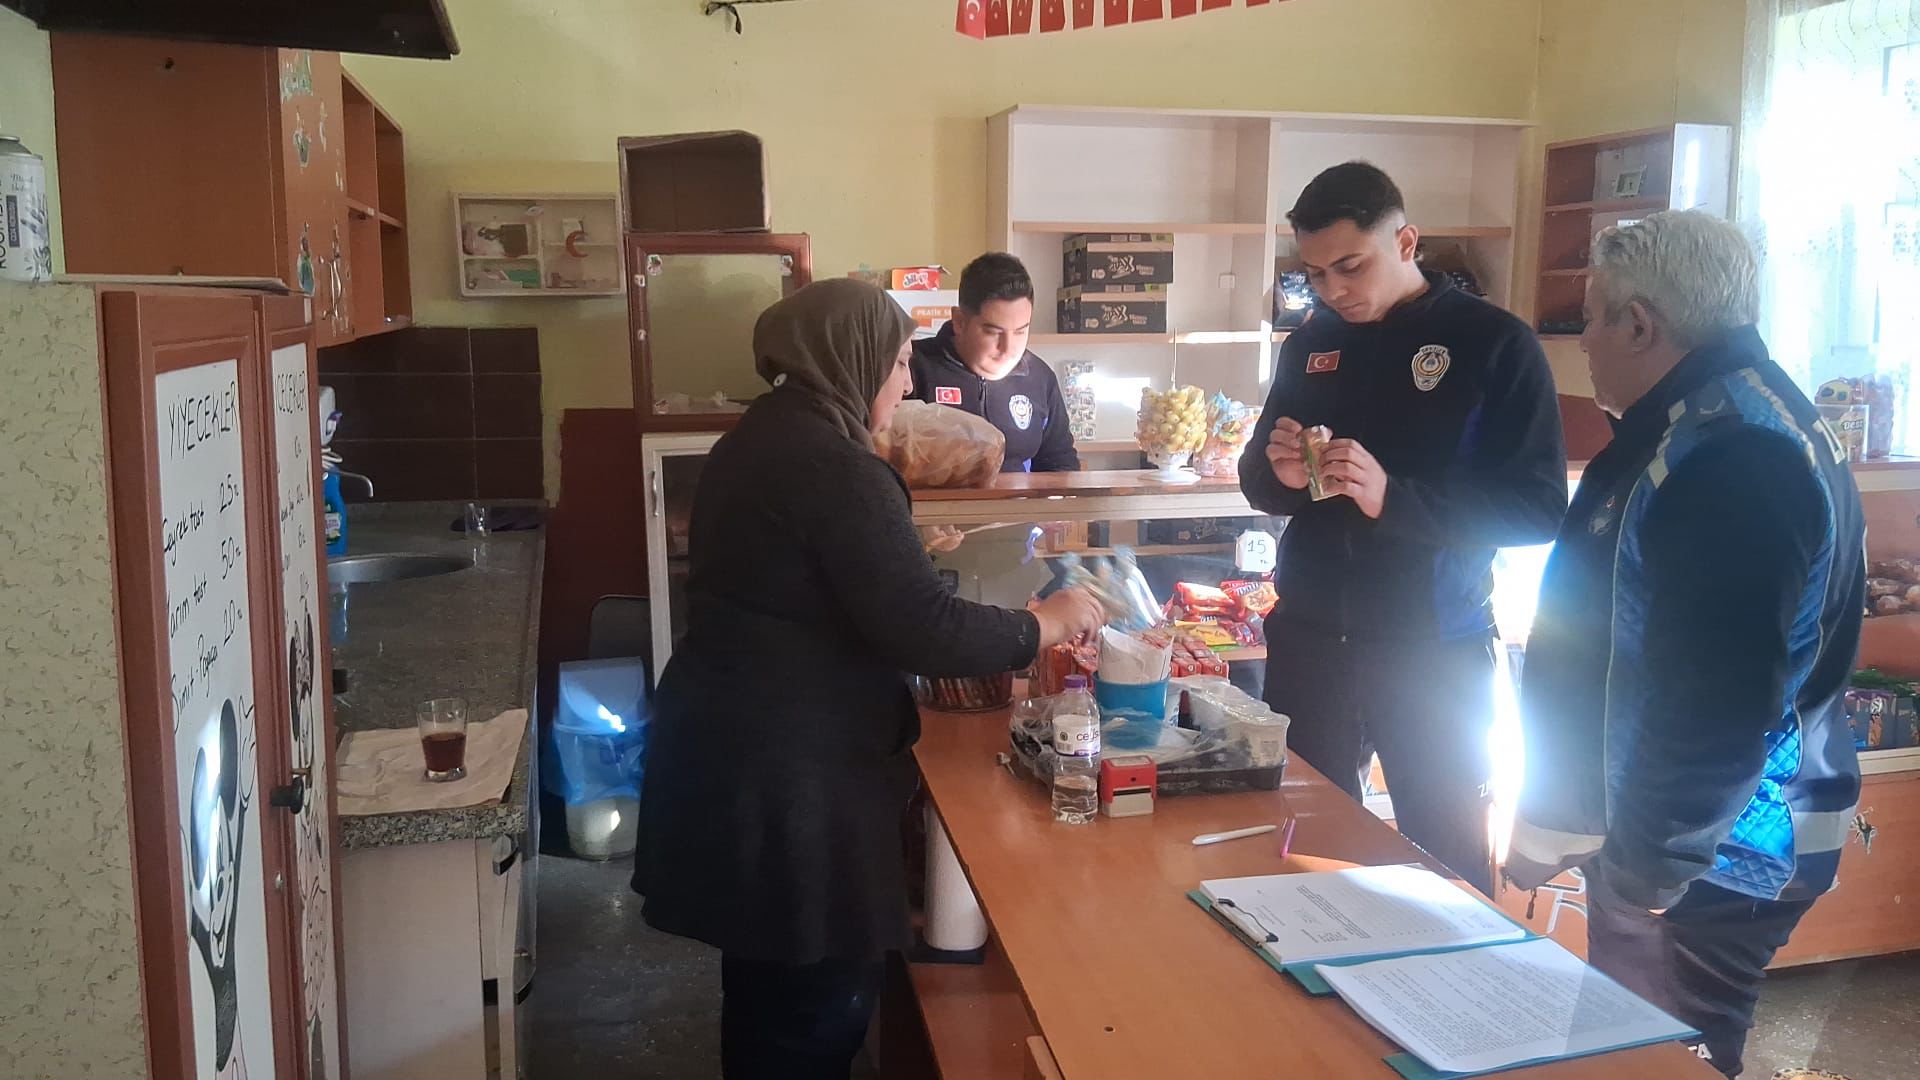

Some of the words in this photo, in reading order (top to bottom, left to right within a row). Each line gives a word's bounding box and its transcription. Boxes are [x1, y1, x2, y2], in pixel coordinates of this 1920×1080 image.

[169, 381, 239, 460] YİYECEKLER
[190, 499, 204, 533] tost
[219, 474, 234, 513] 25
[193, 572, 207, 606] tost
[221, 537, 235, 580] 50
[1247, 539, 1267, 555] 15
[223, 600, 236, 646] 20
